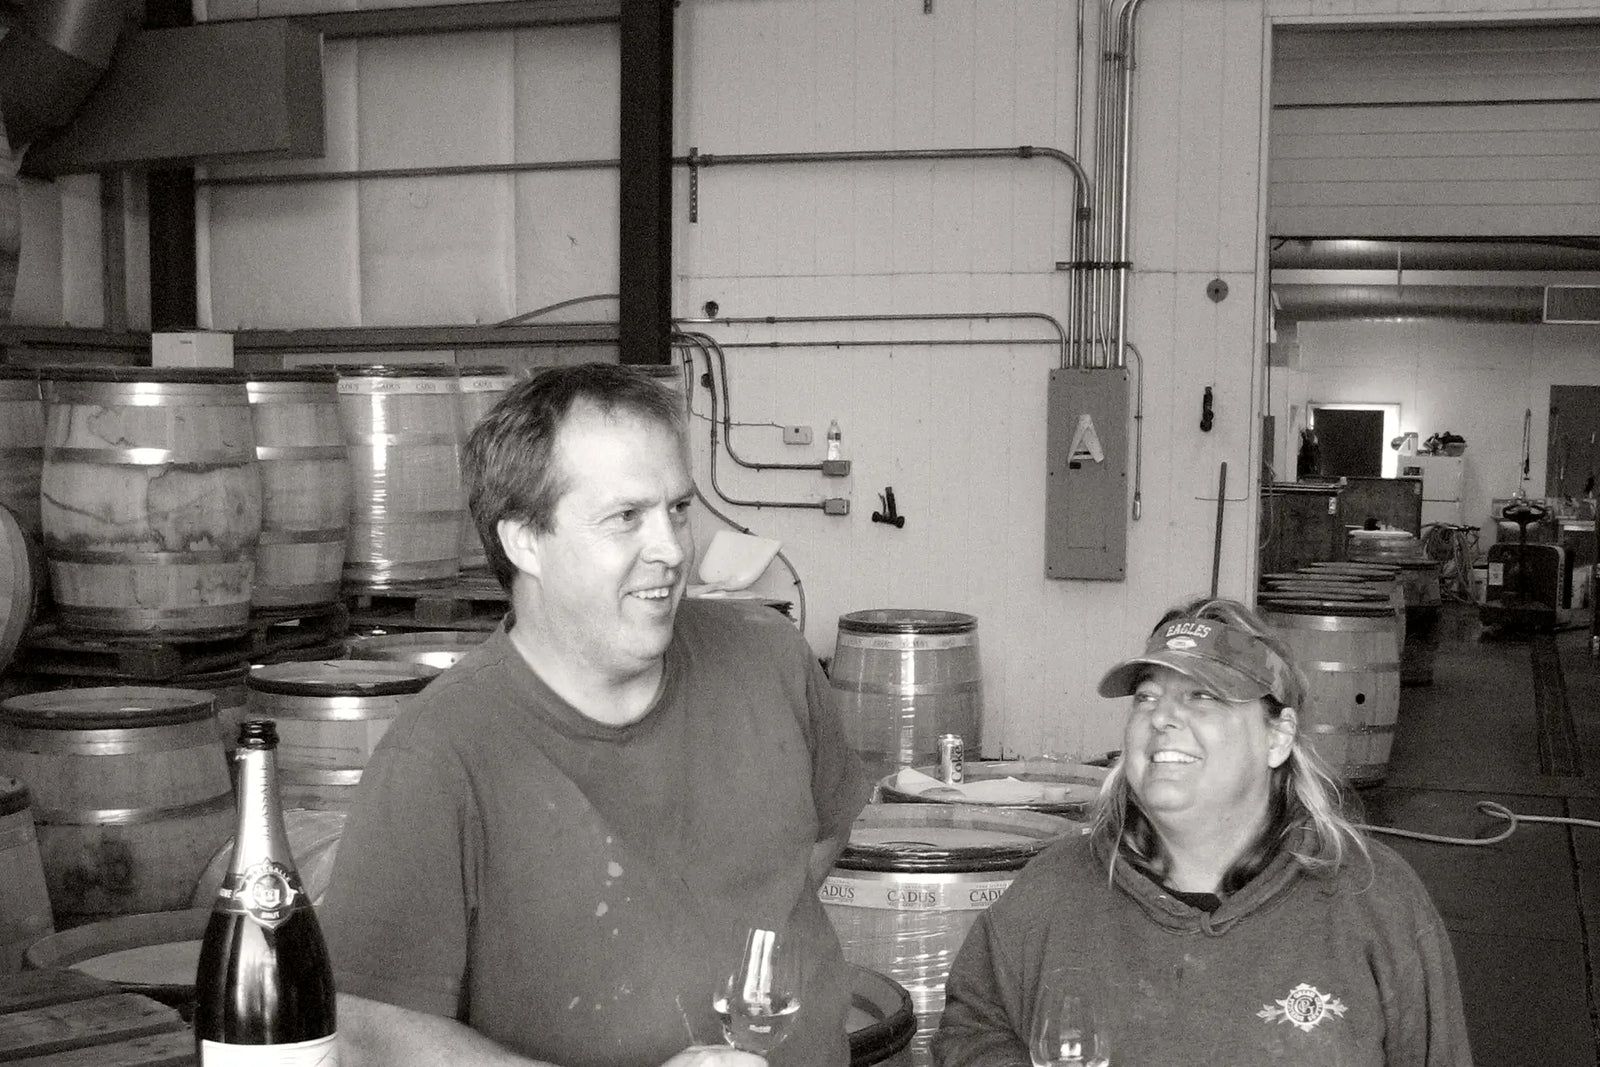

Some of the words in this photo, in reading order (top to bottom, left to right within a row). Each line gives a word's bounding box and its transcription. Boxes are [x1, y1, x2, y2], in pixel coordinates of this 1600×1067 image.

[1068, 414, 1104, 463] A
[1165, 622, 1212, 638] EAGLES
[951, 745, 963, 783] Coke
[887, 890, 936, 903] CADUS
